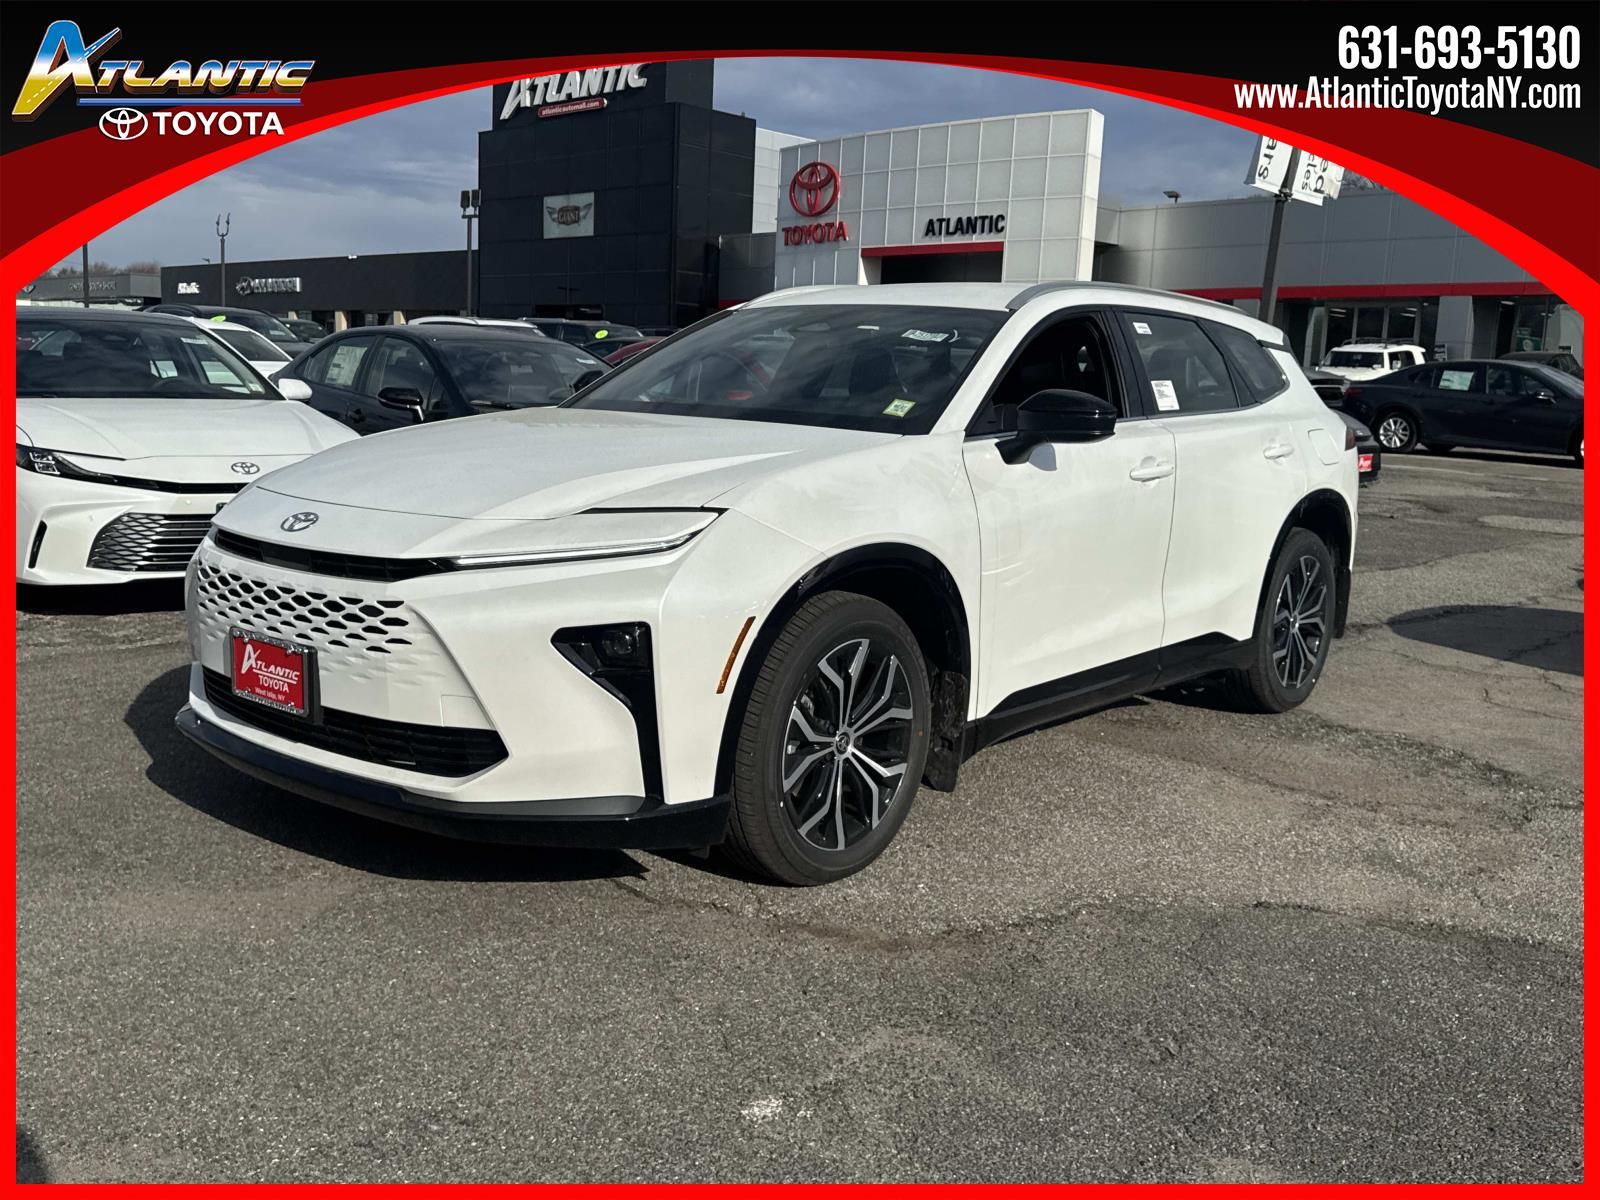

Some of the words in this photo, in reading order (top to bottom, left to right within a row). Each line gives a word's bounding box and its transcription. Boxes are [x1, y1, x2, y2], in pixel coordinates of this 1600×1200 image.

[500, 63, 648, 120] ATLANTIC
[781, 220, 850, 247] TOYOTA
[924, 214, 1006, 237] ATLANTIC
[241, 643, 300, 681] ATLANTIC
[258, 675, 290, 693] TOYOTA
